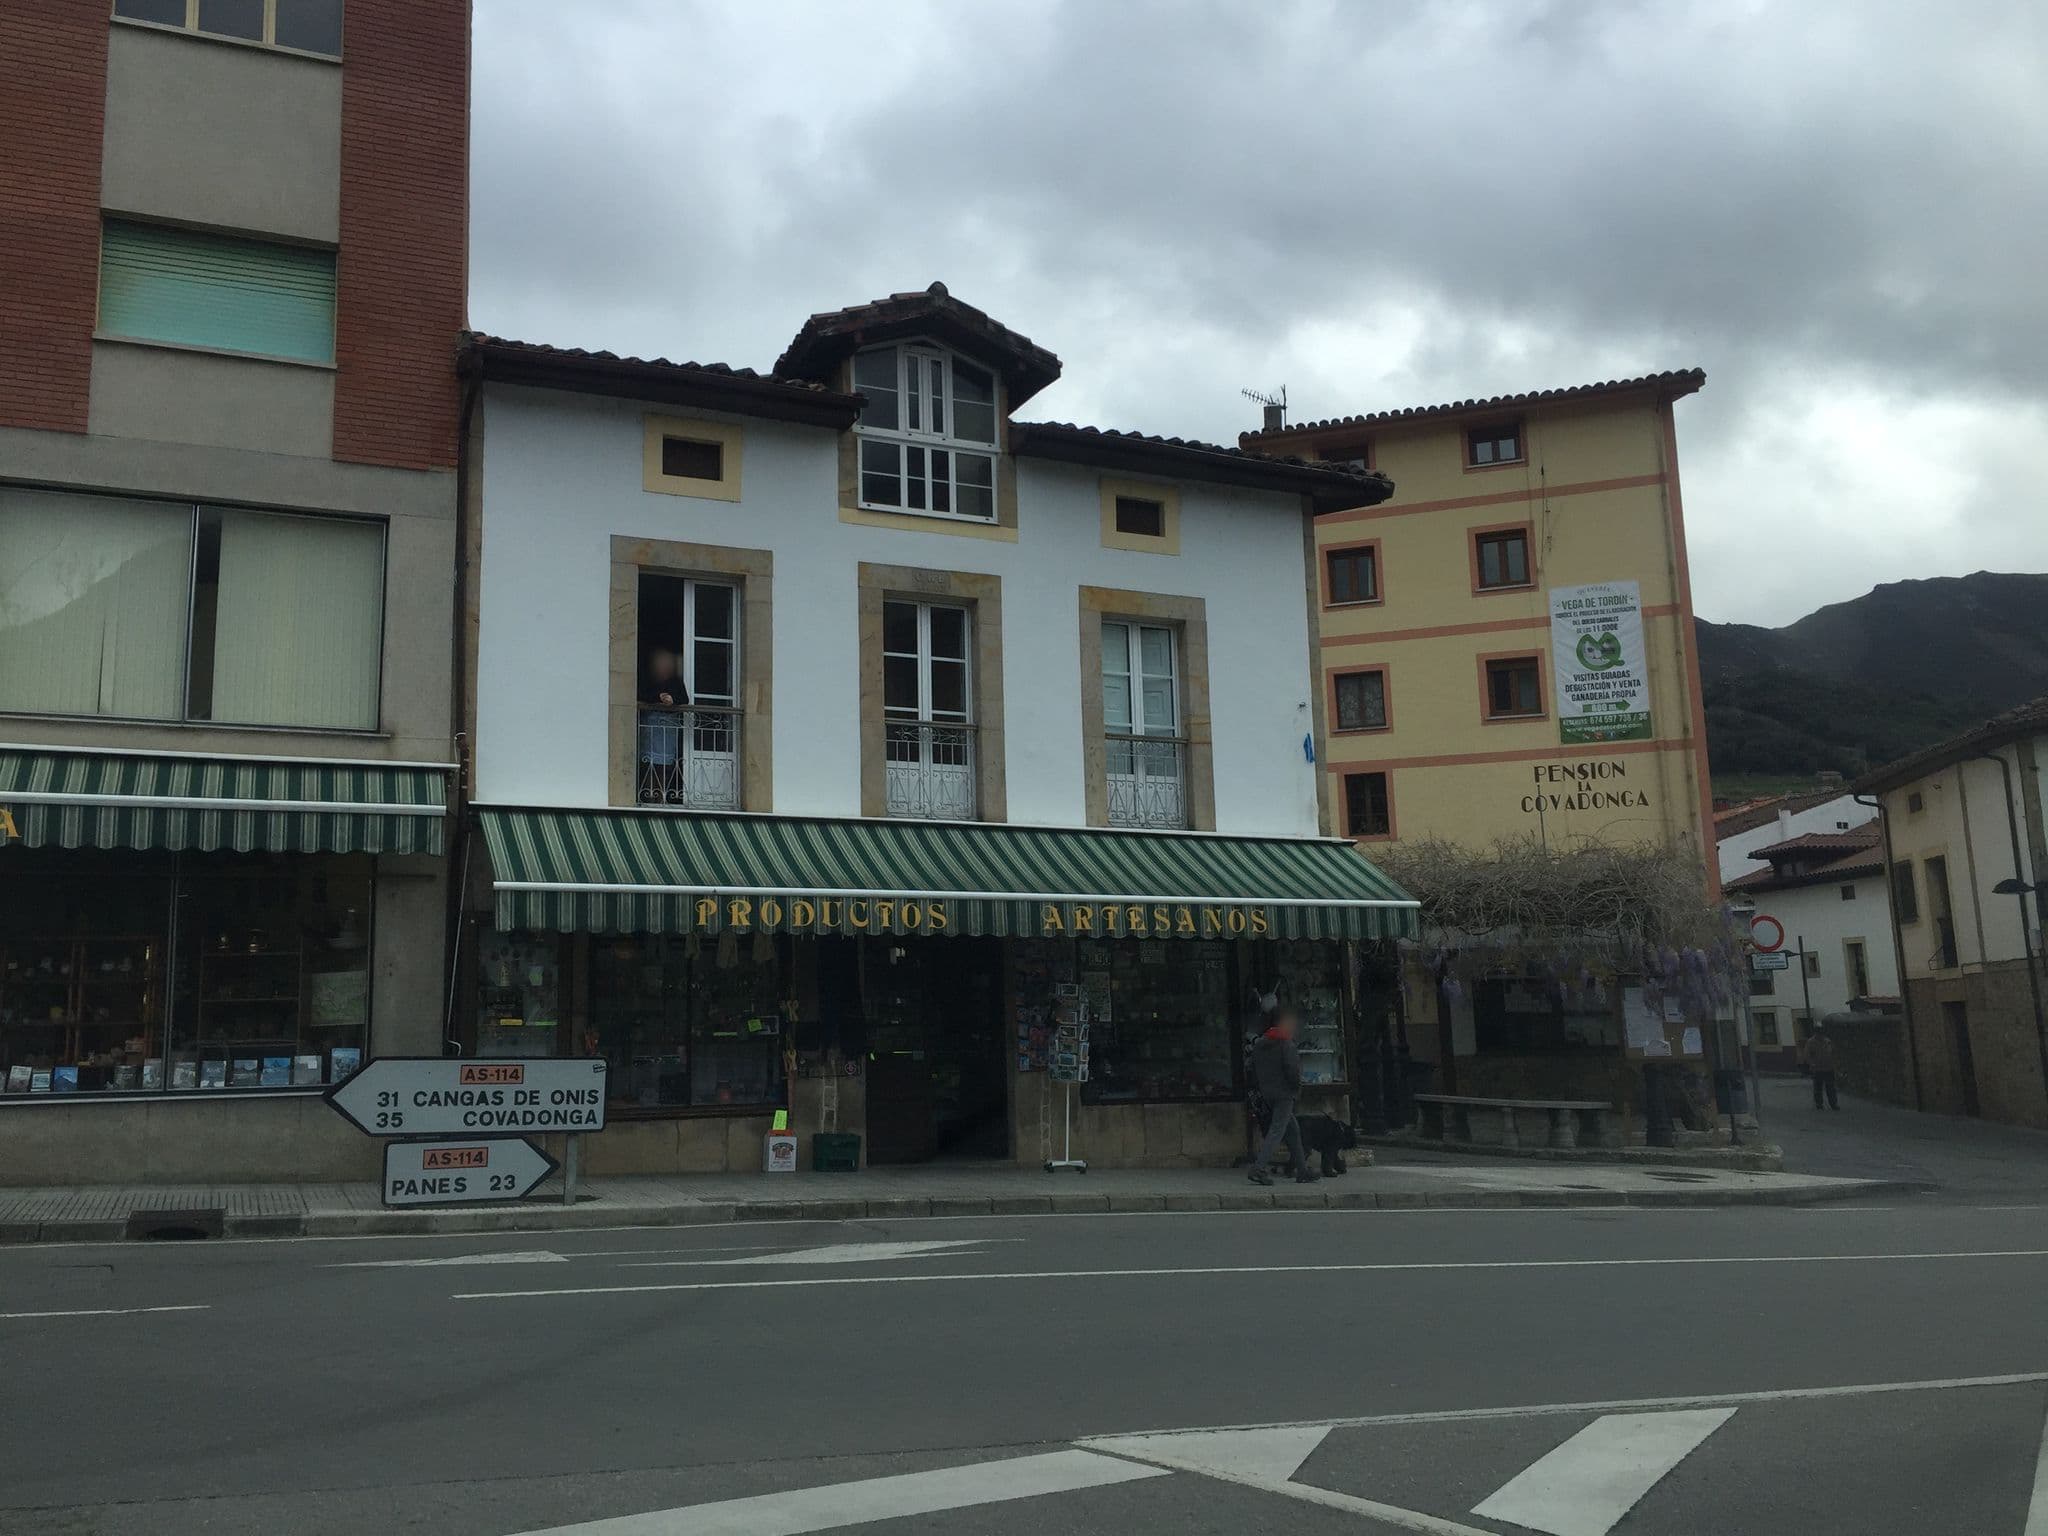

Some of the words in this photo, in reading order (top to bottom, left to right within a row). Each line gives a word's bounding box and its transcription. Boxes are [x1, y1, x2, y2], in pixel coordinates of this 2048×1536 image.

[1561, 599, 1584, 610] VEGA
[1585, 597, 1597, 608] DE
[1573, 672, 1600, 682] VISITAS
[1601, 670, 1631, 680] GUIADAS
[1612, 682, 1618, 690] Y
[1618, 678, 1641, 689] VENTA
[1611, 689, 1637, 699] PROPIA
[1534, 760, 1626, 783] PENSION
[1578, 781, 1592, 792] LA
[1521, 789, 1649, 813] COVADONGA
[695, 899, 948, 929] PRODUCTOS
[1042, 905, 1268, 933] ARTESANOS
[464, 1067, 520, 1081] AS-114
[377, 1092, 399, 1107] 31
[413, 1090, 504, 1107] CANGAS
[513, 1090, 540, 1106] DE
[550, 1089, 600, 1105] ONIS
[376, 1112, 403, 1128] 35
[463, 1109, 598, 1127] COVADONGA
[427, 1151, 484, 1166] AS-114
[391, 1176, 468, 1196] PANES
[489, 1175, 516, 1191] 23
